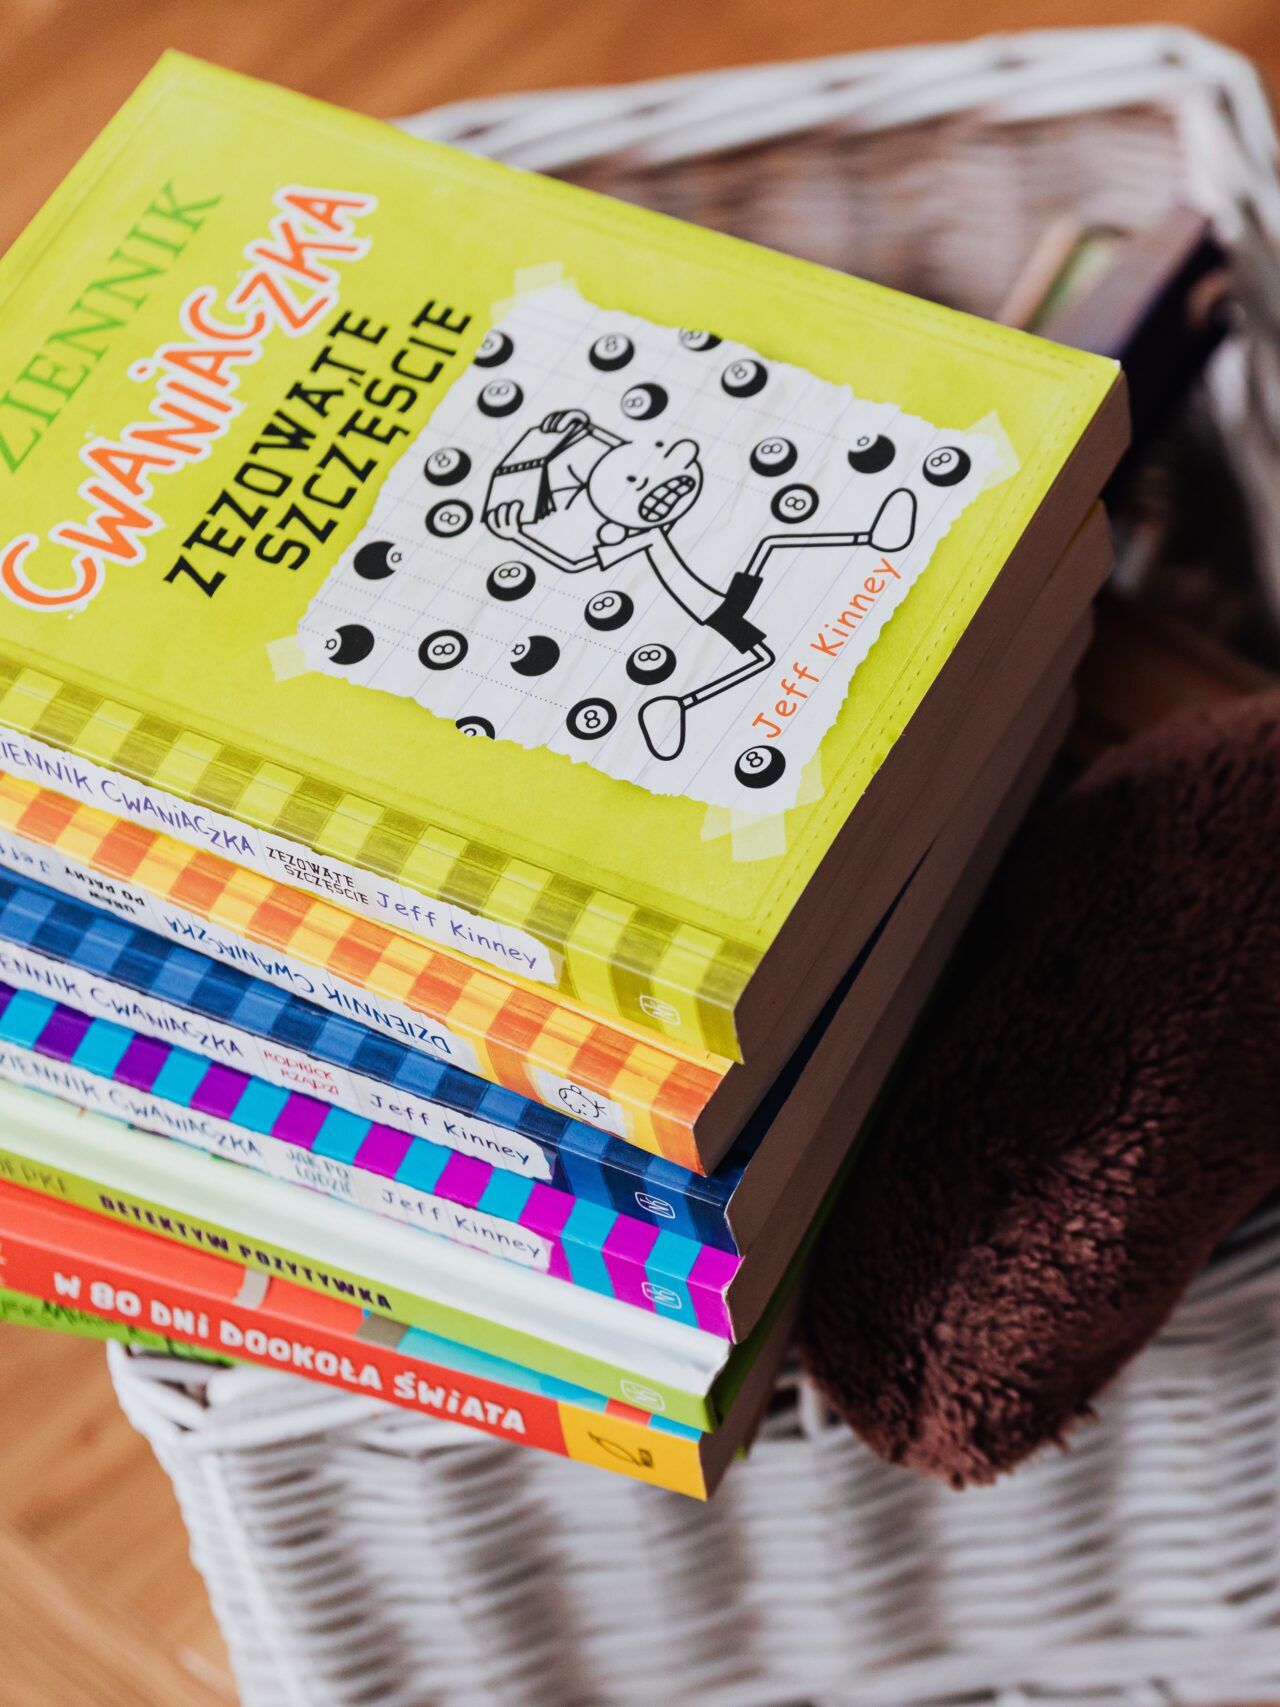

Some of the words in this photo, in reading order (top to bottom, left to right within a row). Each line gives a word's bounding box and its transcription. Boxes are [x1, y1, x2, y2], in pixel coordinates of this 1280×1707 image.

[163, 310, 390, 599] ZEZOWATE
[254, 299, 474, 572] SZCZĘŚCIE
[752, 661, 821, 740] Jeff
[810, 557, 903, 660] Kinney
[0, 741, 94, 795] IENNIK
[122, 889, 145, 906] PO
[266, 846, 354, 888] ZEZOWATE
[376, 890, 436, 927] Jeff
[450, 920, 538, 969] Kinney
[322, 982, 451, 1054] DZIENNIK
[371, 1093, 429, 1126] Jeff
[444, 1122, 530, 1165] Kinney
[98, 1193, 230, 1252] DETEKTYW
[238, 1243, 393, 1311] POZYTYWKA
[382, 1188, 441, 1222] Jeff
[454, 1214, 541, 1259] Kinney
[54, 1271, 82, 1299] W
[90, 1281, 142, 1318] 80
[219, 1321, 384, 1392] DOOKOŁA
